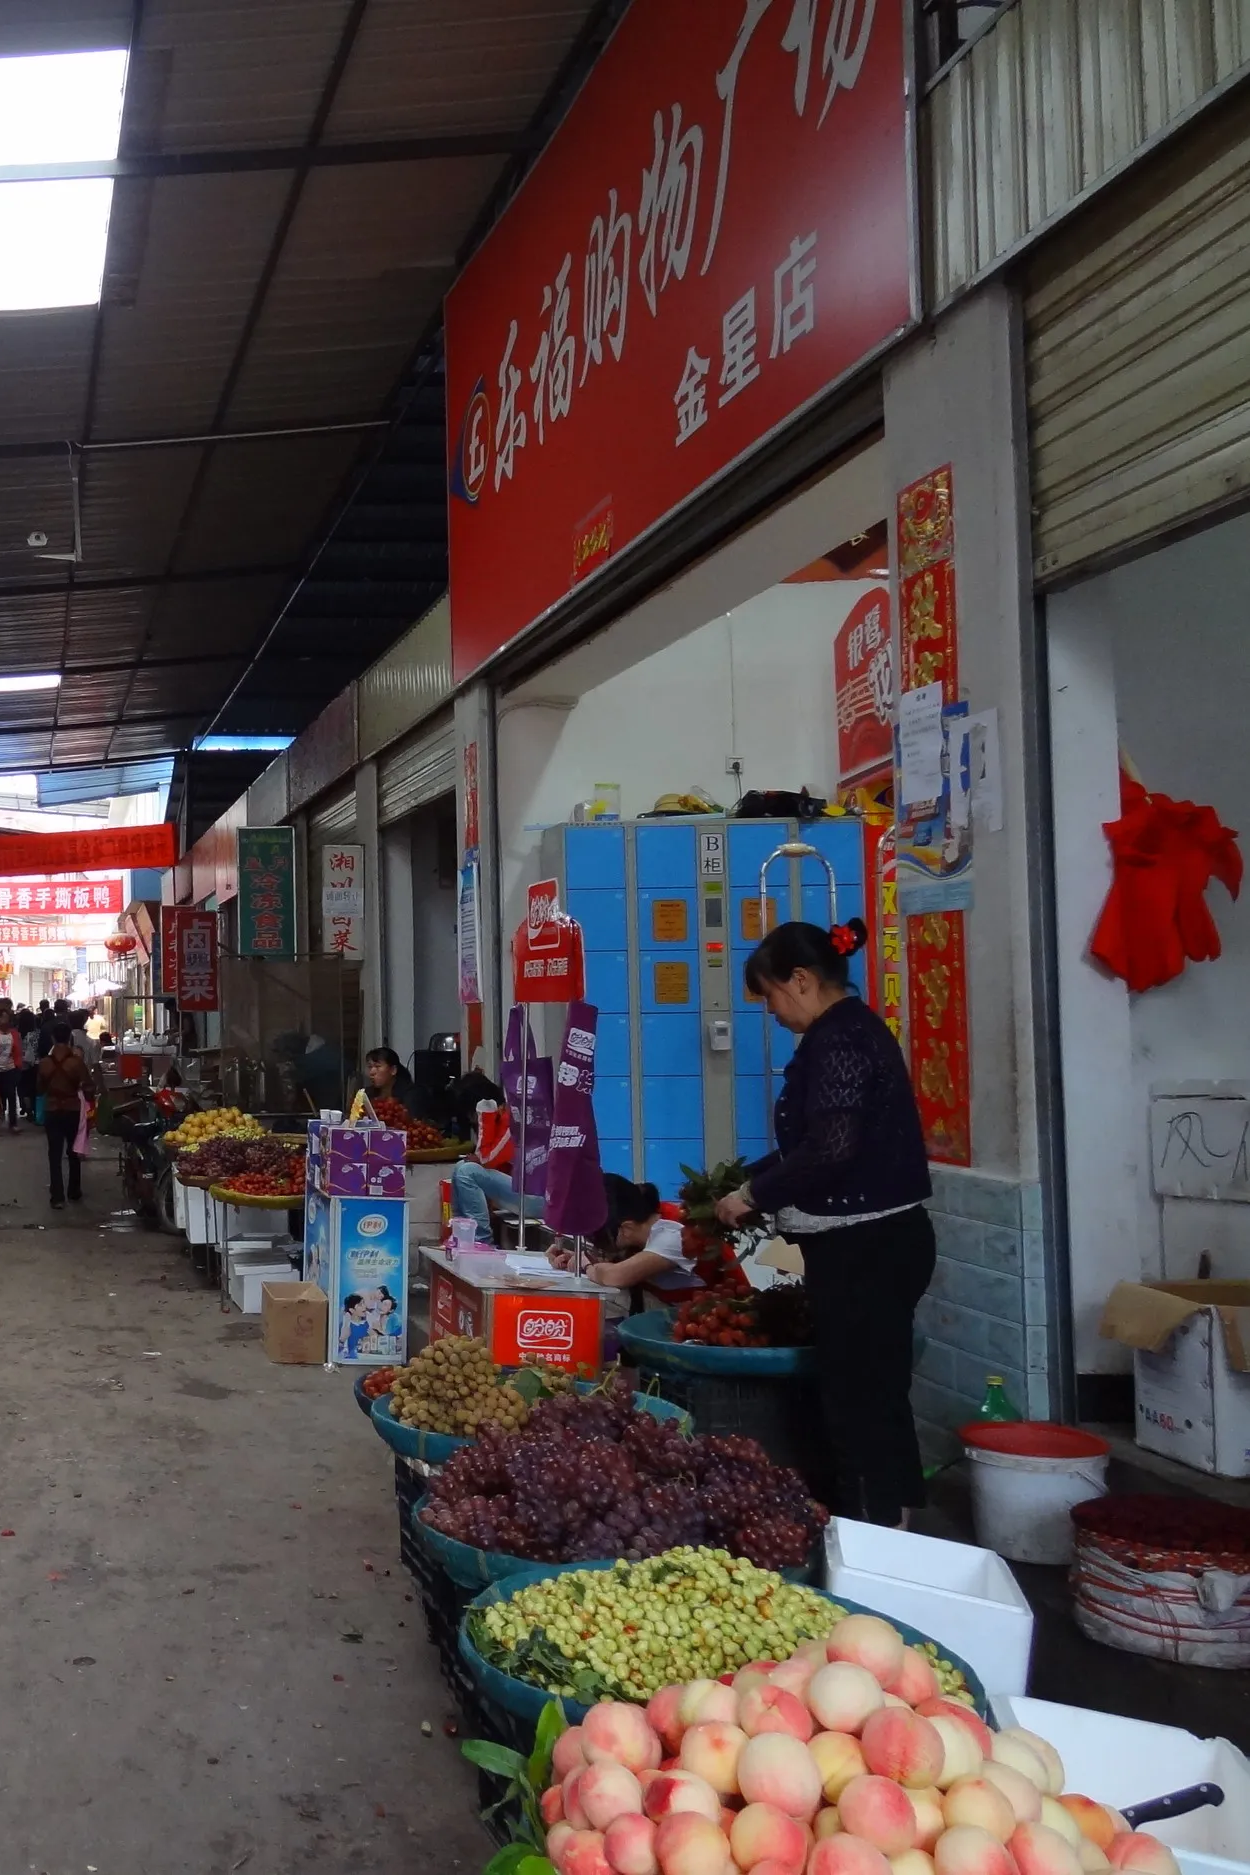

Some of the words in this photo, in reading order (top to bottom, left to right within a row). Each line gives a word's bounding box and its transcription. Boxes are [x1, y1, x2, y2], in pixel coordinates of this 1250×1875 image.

[674, 230, 818, 448] 金星店
[706, 836, 720, 851] B
[704, 857, 721, 872] 柜
[330, 851, 358, 953] 湘川菜
[518, 1352, 571, 1362] 中名商标
